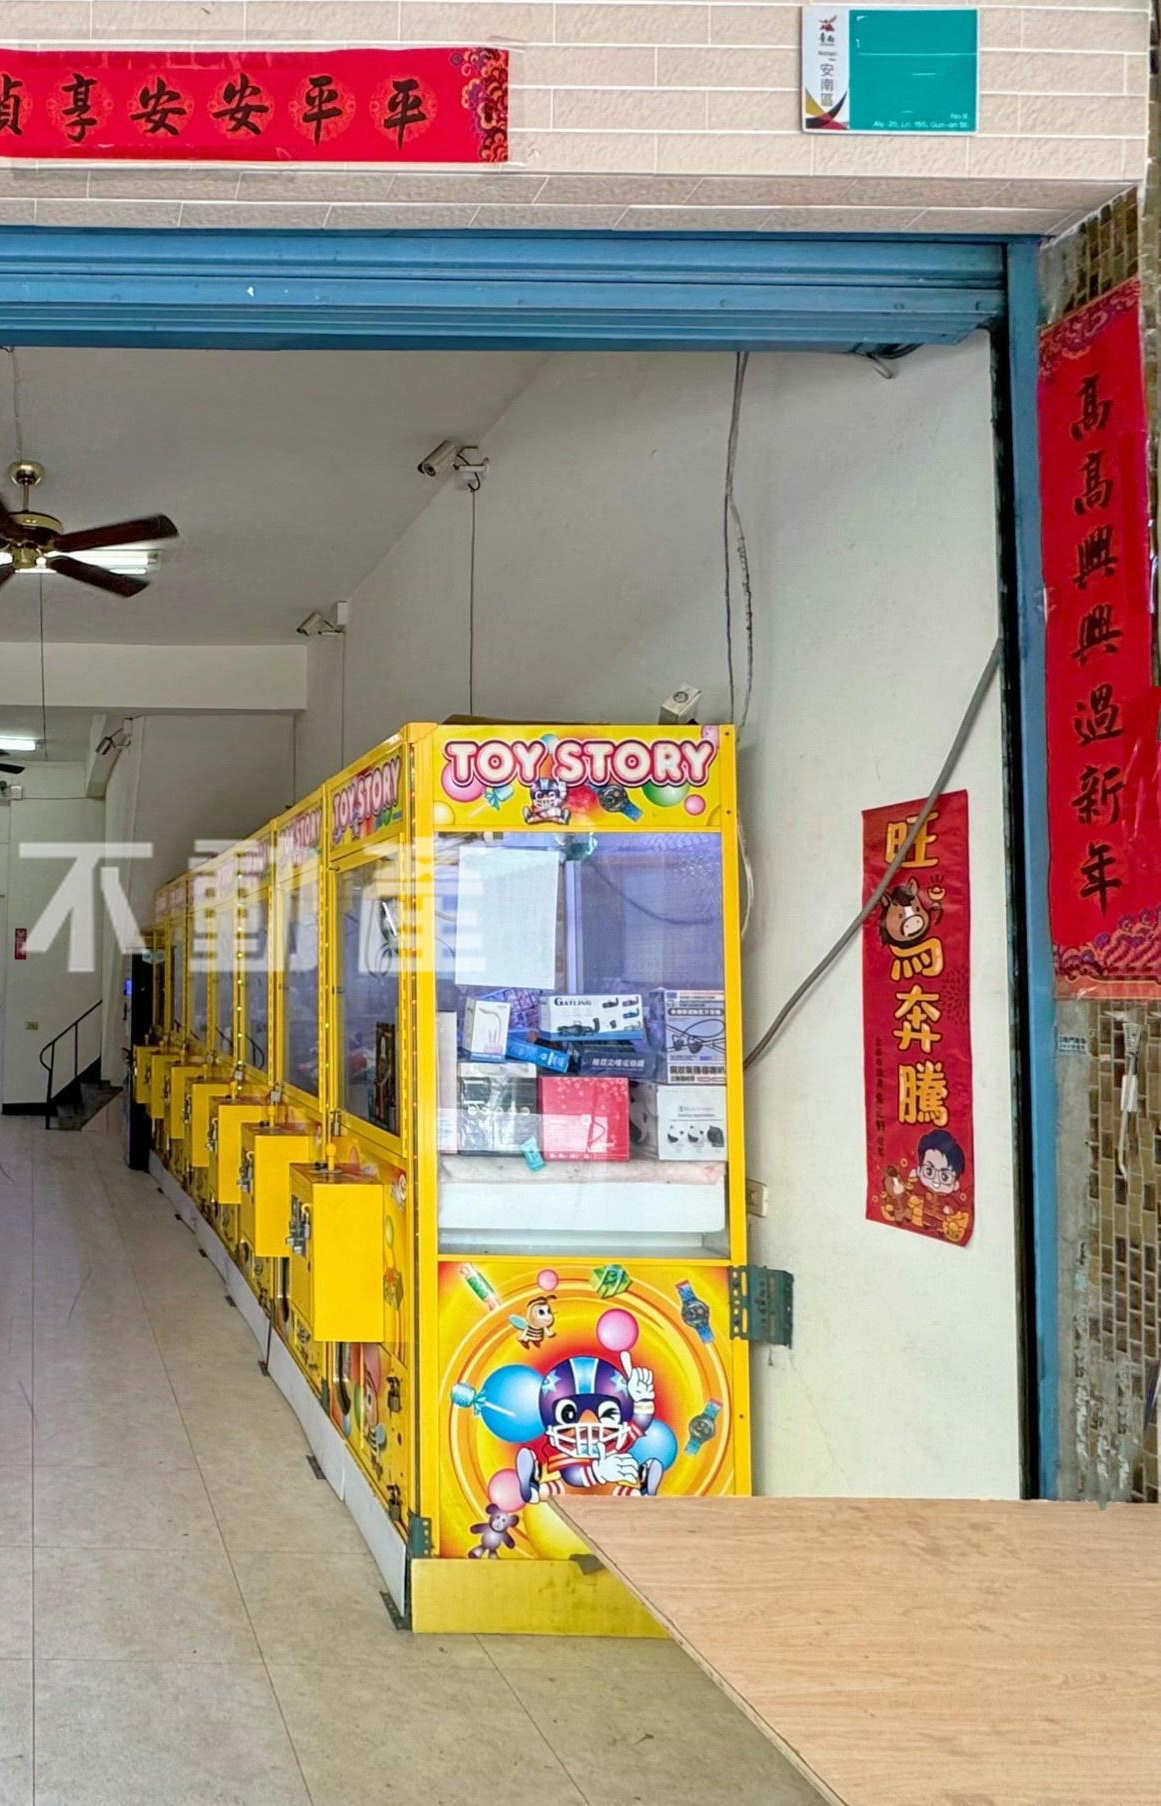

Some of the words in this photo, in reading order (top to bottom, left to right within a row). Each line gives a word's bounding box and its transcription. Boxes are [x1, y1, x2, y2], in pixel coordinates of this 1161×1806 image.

[332, 782, 356, 835] TOY
[356, 754, 401, 822] STORY
[443, 738, 549, 788] TOY
[551, 738, 719, 788] STORY
